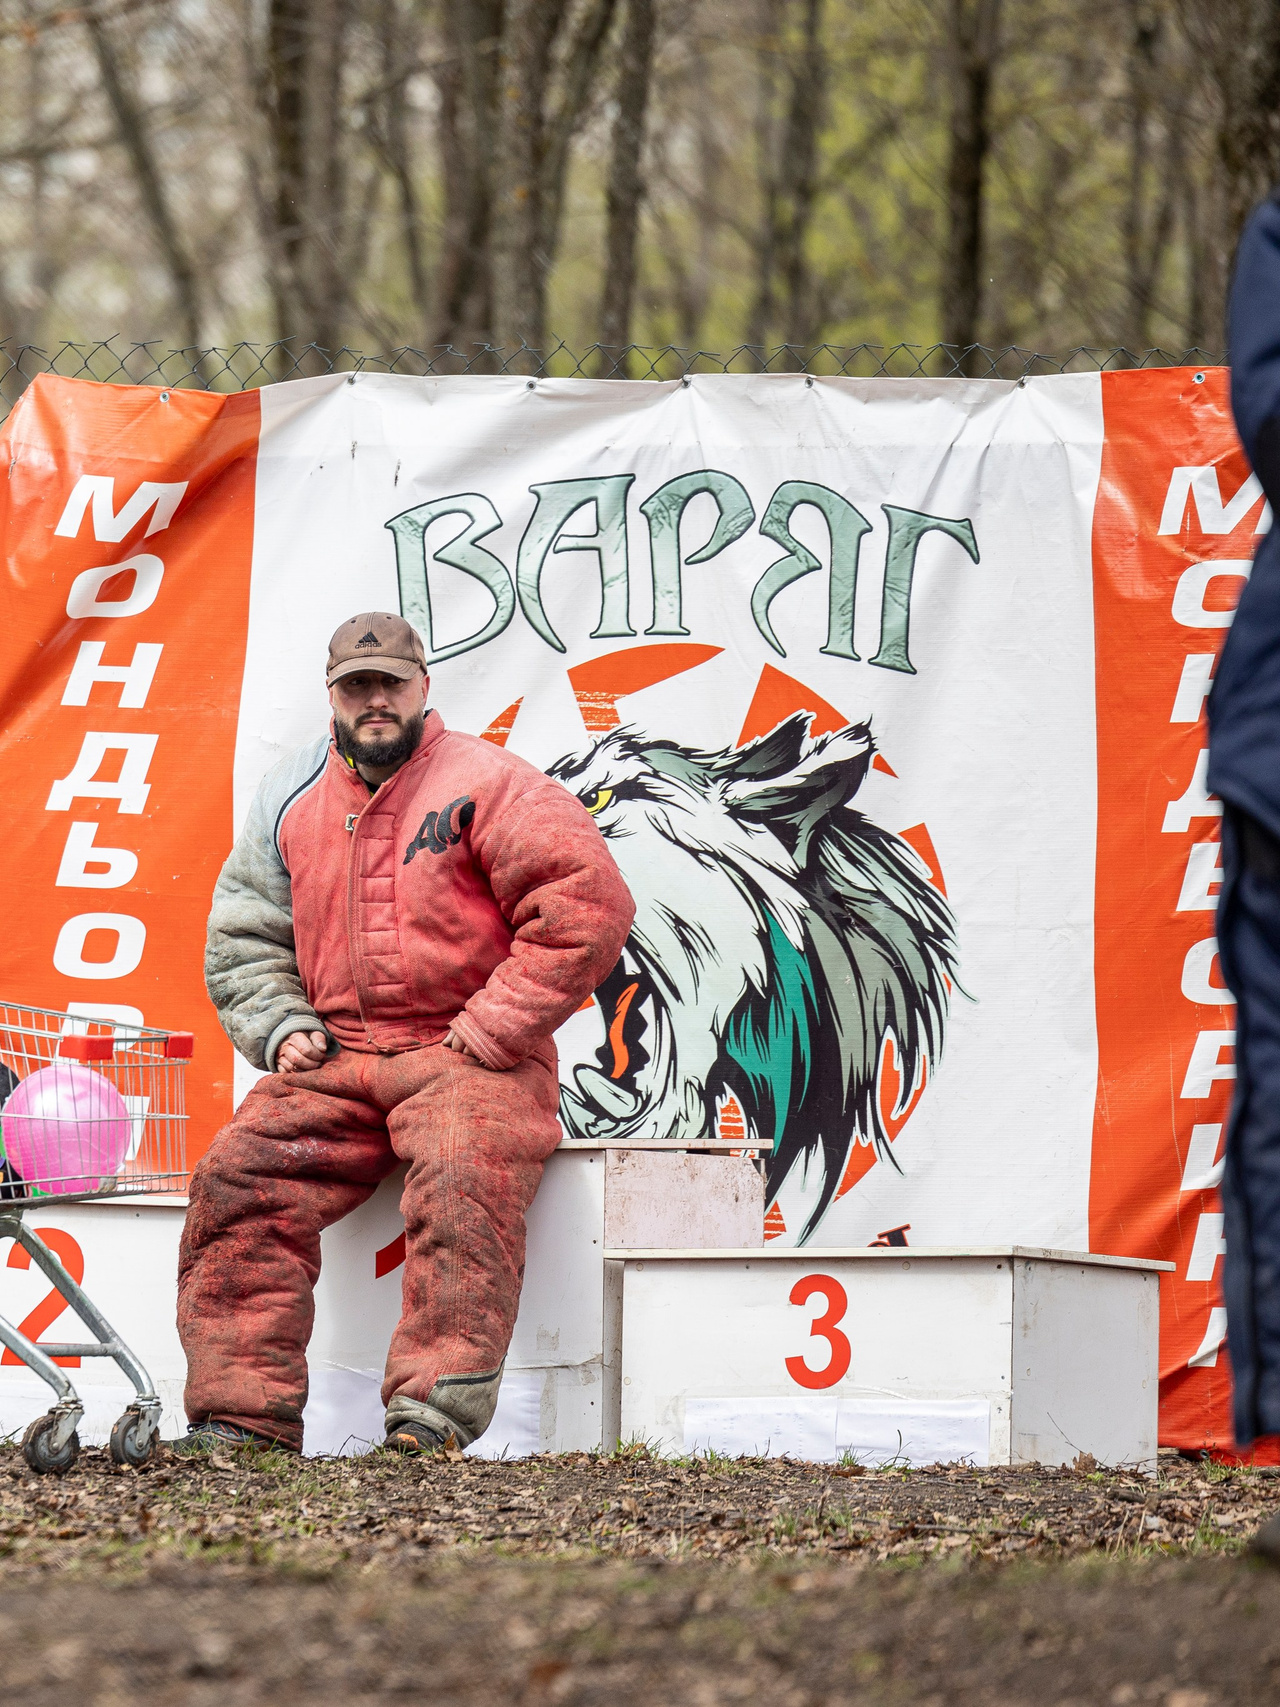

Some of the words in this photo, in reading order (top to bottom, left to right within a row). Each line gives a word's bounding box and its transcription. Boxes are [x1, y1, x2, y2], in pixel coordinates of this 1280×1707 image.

[384, 468, 980, 675] ВАРЯГ
[0, 1227, 85, 1368] 2
[785, 1274, 851, 1389] 3
